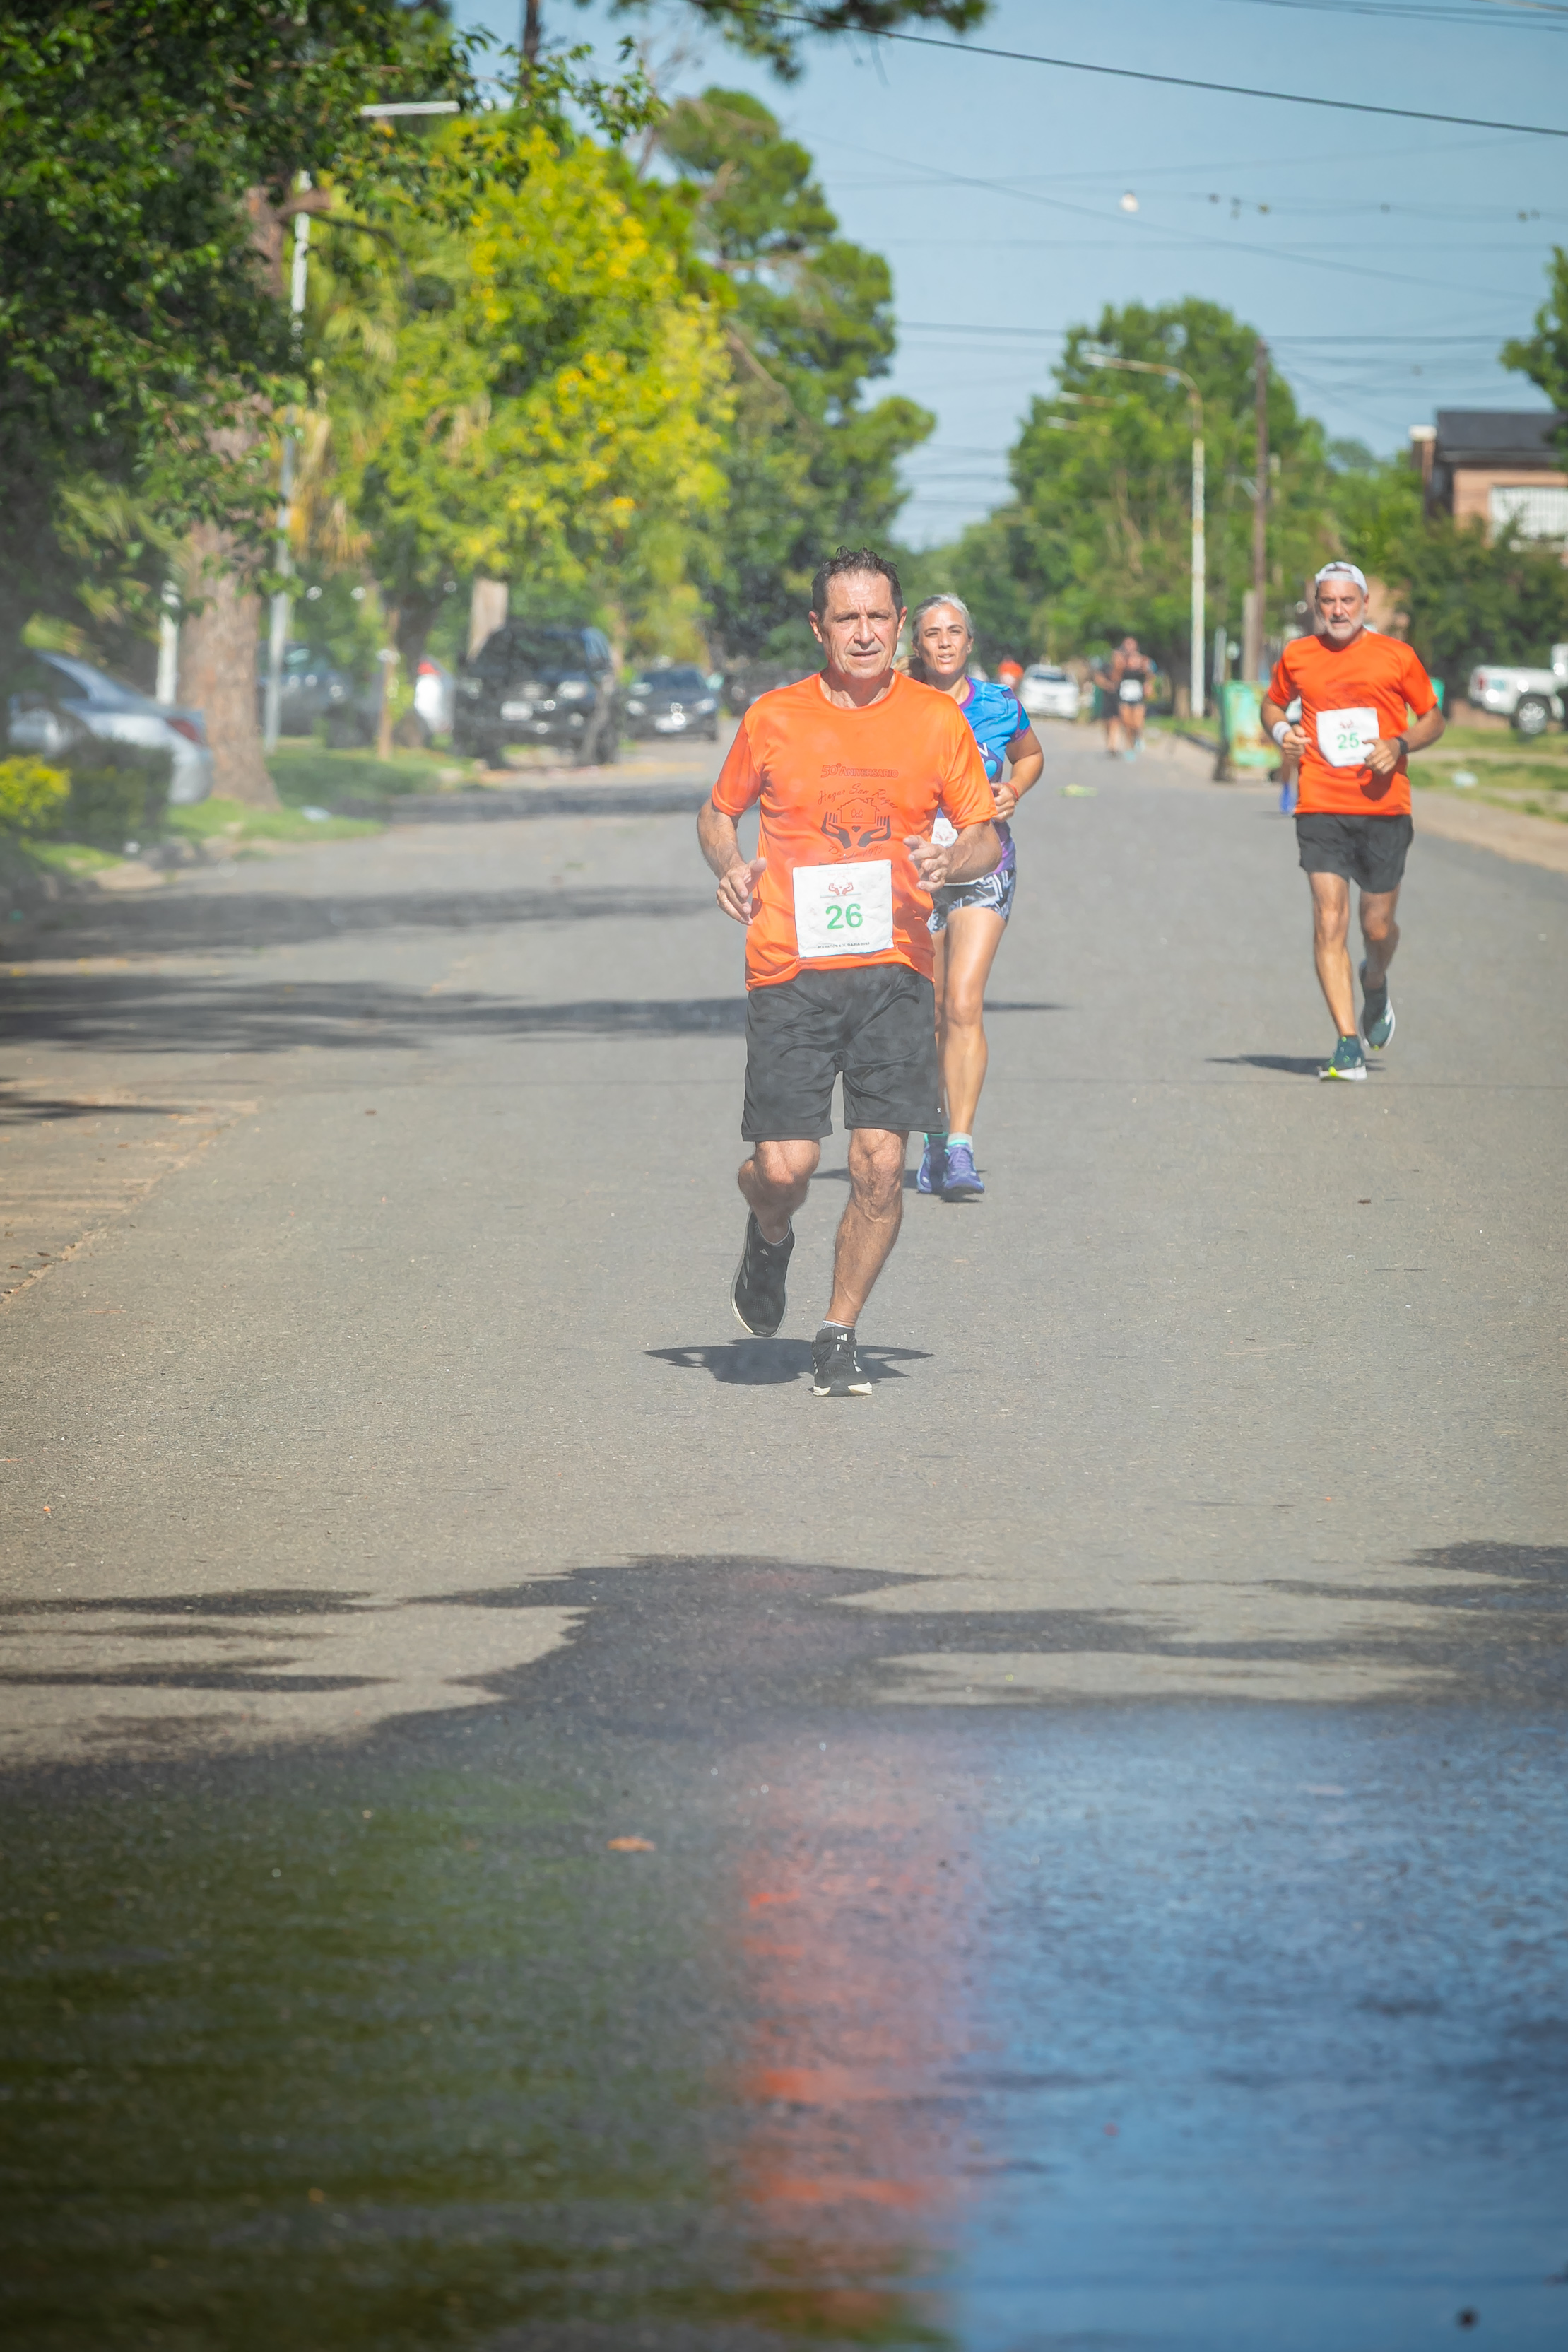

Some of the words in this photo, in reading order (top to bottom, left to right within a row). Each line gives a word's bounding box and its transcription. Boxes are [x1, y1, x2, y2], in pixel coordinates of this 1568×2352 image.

[1337, 732, 1360, 750] 25
[839, 766, 899, 778] ANIVERSARIO
[848, 782, 869, 794] San
[825, 903, 863, 929] 26
